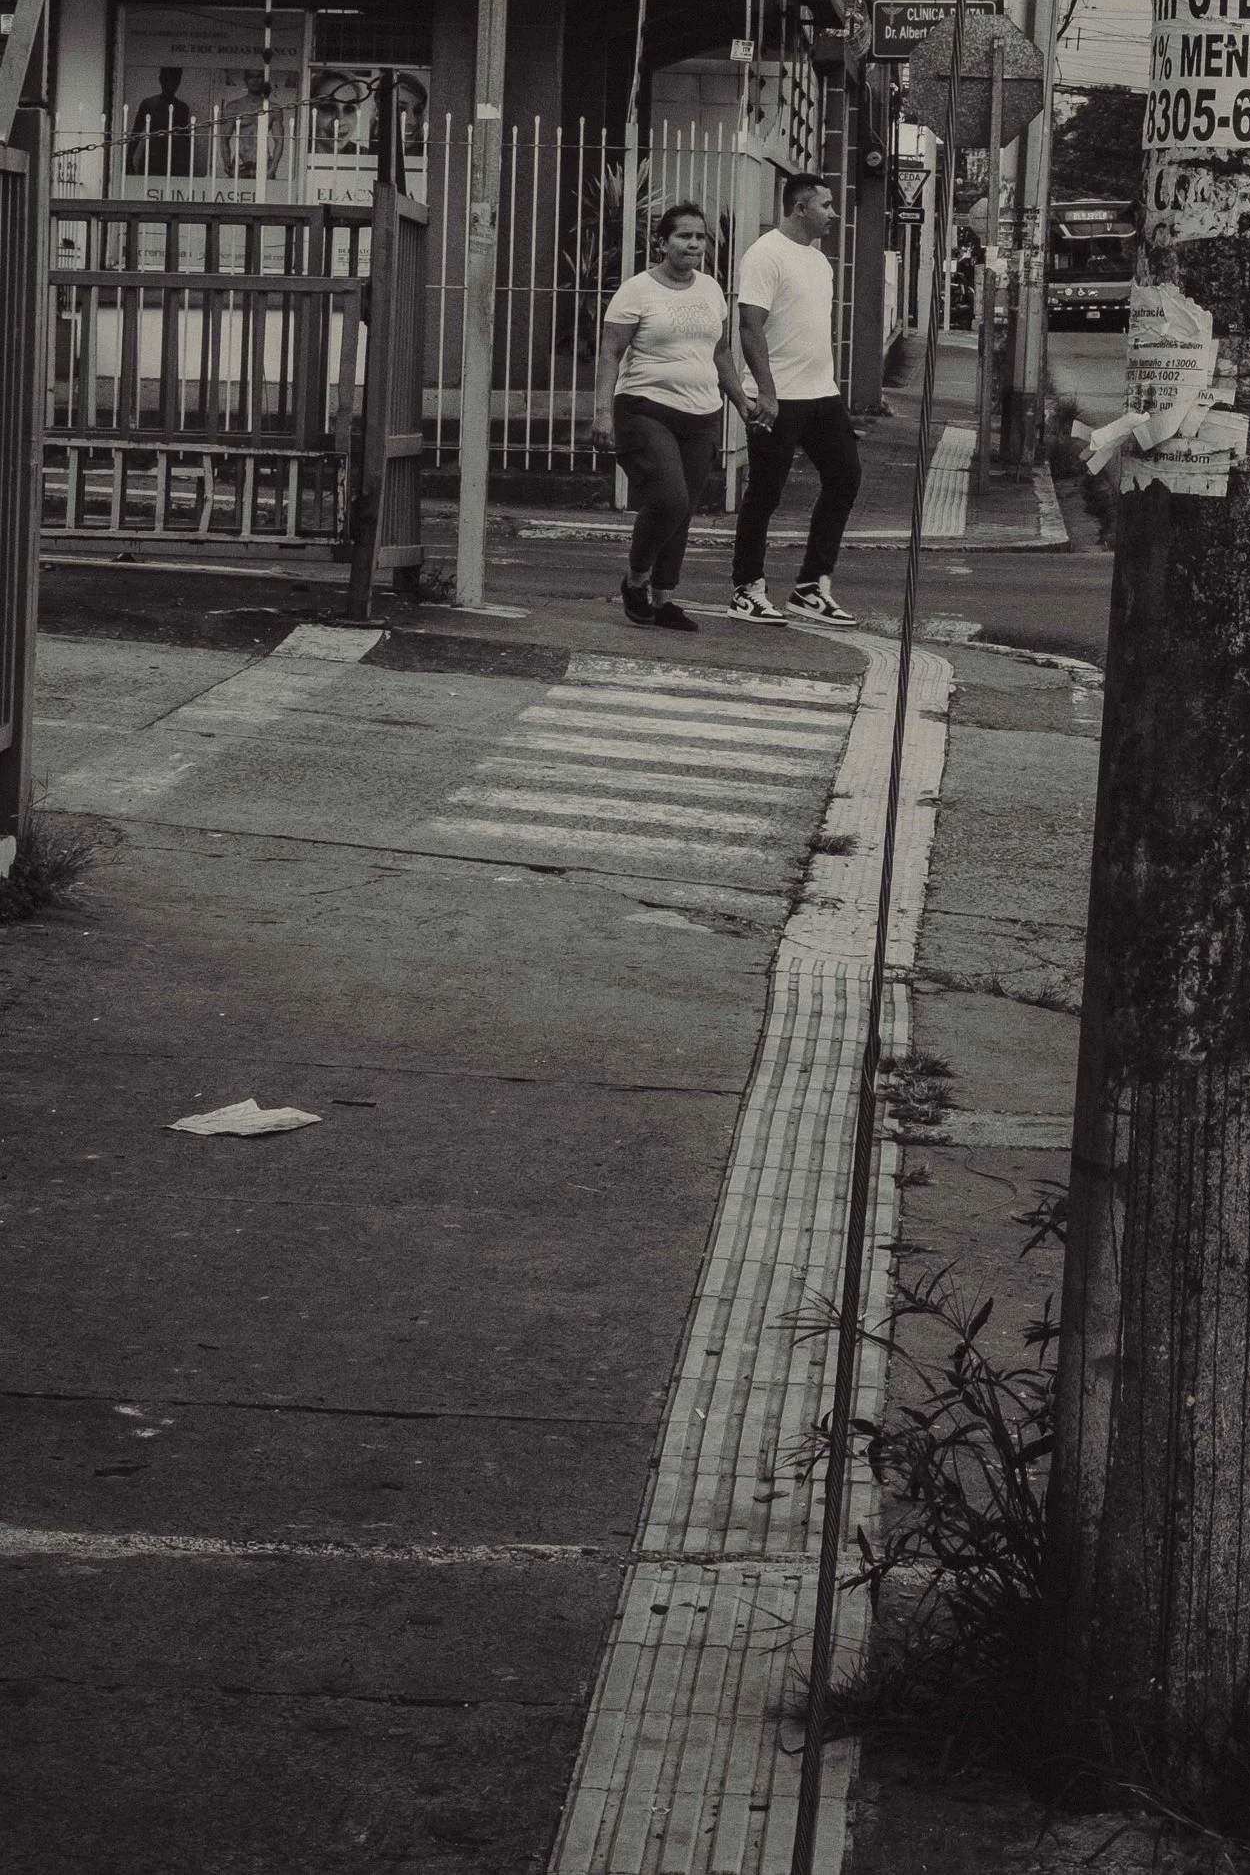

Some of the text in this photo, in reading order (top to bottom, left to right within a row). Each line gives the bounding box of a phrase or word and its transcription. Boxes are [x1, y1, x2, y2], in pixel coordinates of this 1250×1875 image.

[950, 8, 986, 16] DTAL
[885, 26, 897, 39] Dr.
[253, 46, 298, 56] BLNCO
[899, 173, 921, 182] CEDA
[1158, 387, 1179, 397] 2023
